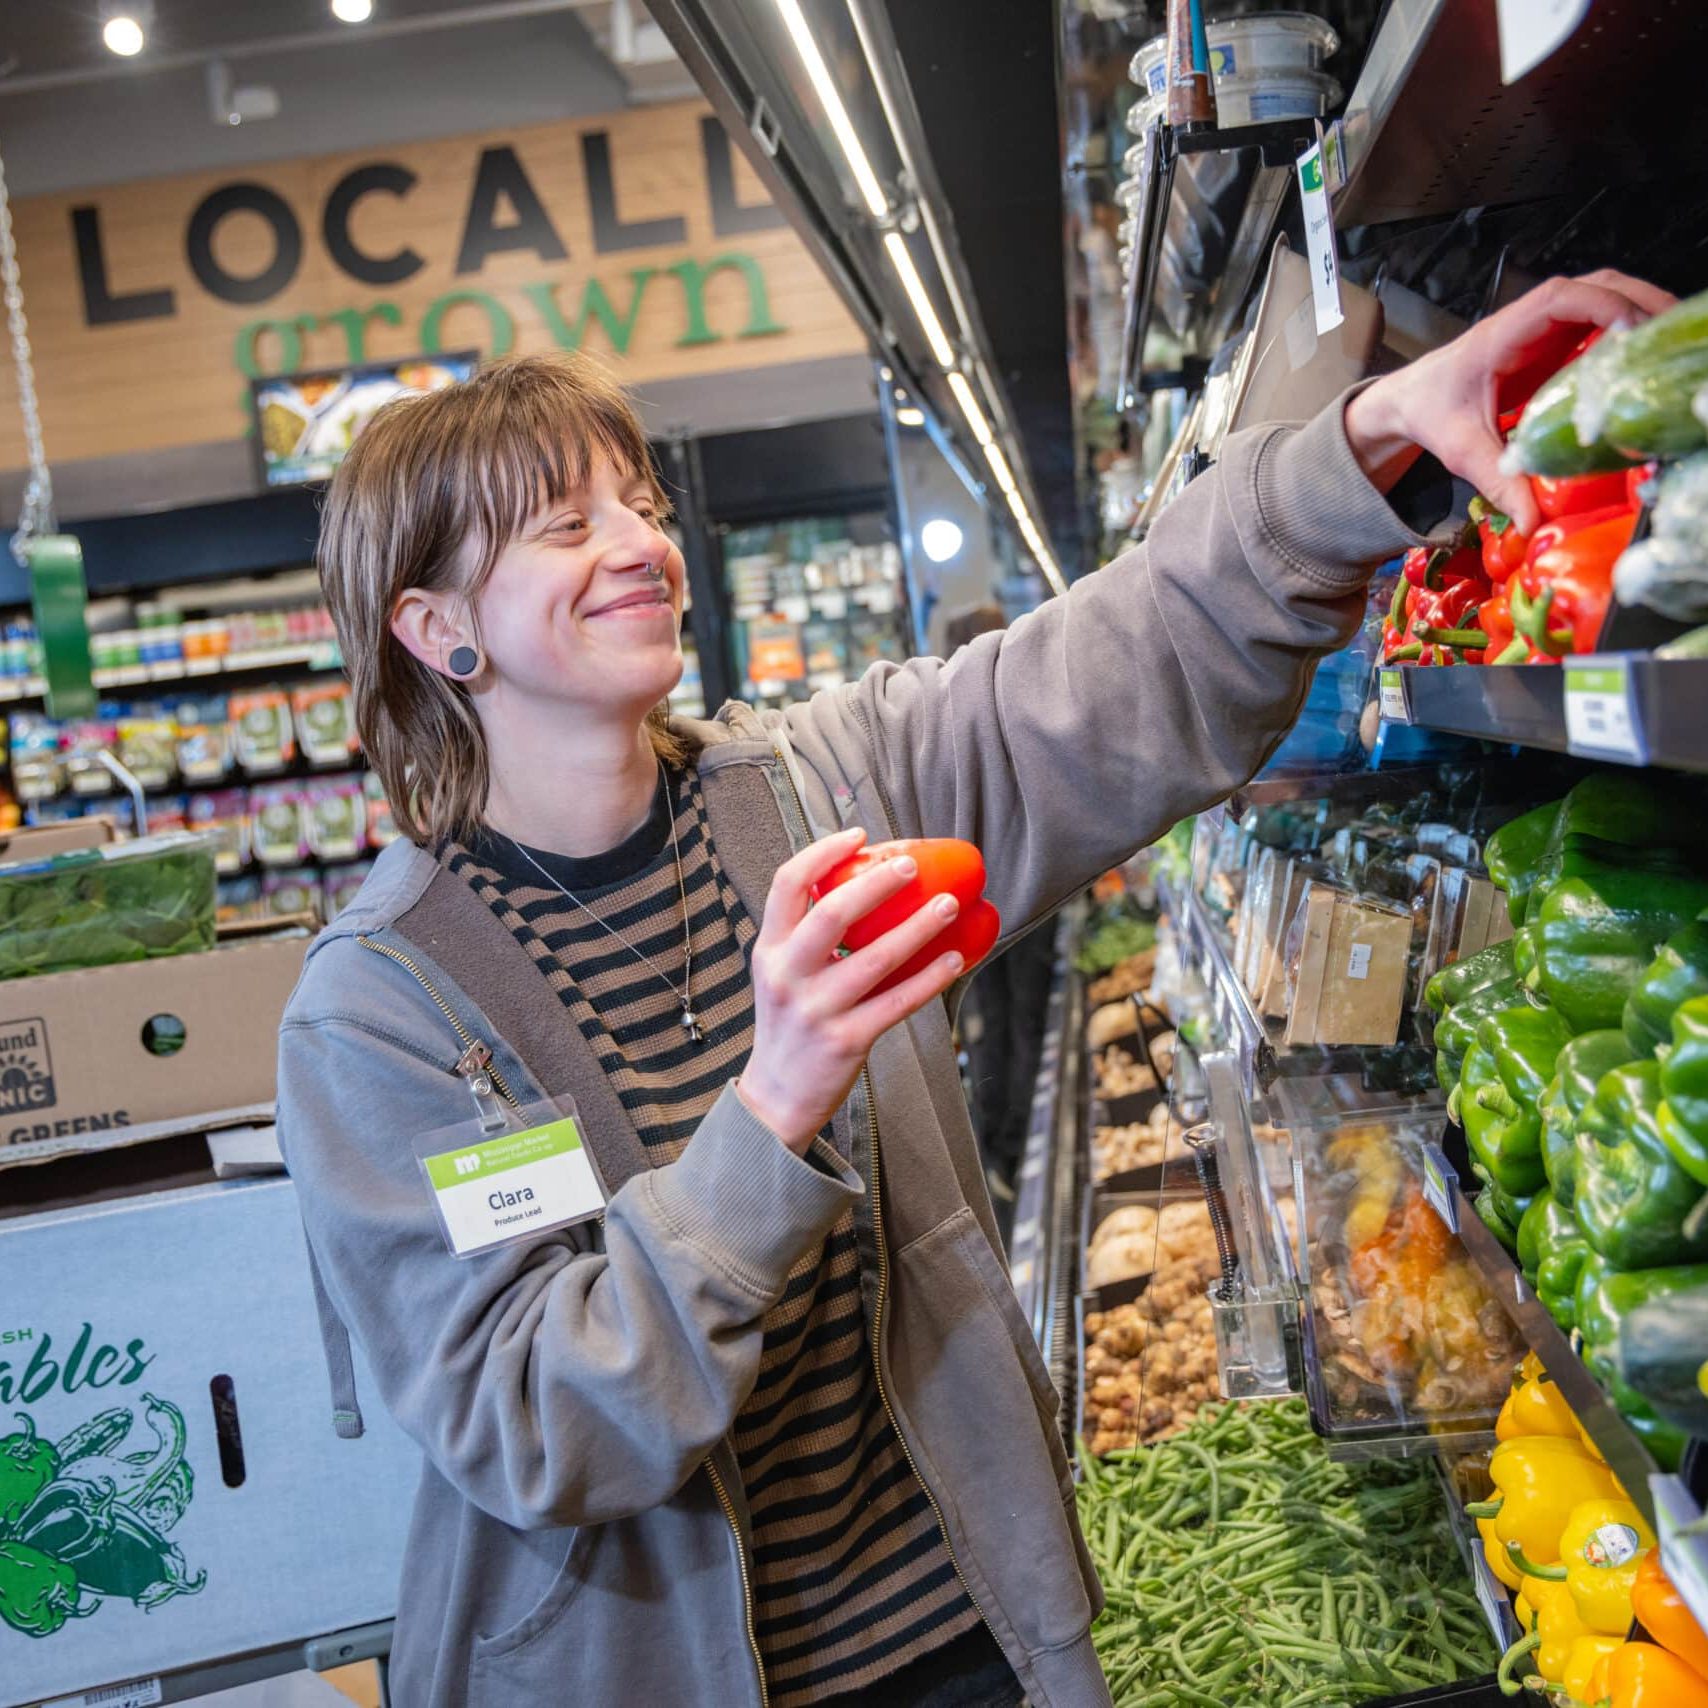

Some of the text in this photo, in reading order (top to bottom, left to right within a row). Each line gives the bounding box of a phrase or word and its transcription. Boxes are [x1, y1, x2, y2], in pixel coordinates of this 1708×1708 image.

[234, 252, 787, 437] grown
[9, 1110, 131, 1145] GREENS
[488, 1187, 534, 1210] Clara
[494, 1206, 542, 1227] Produce Lead
[0, 1328, 33, 1345] SH
